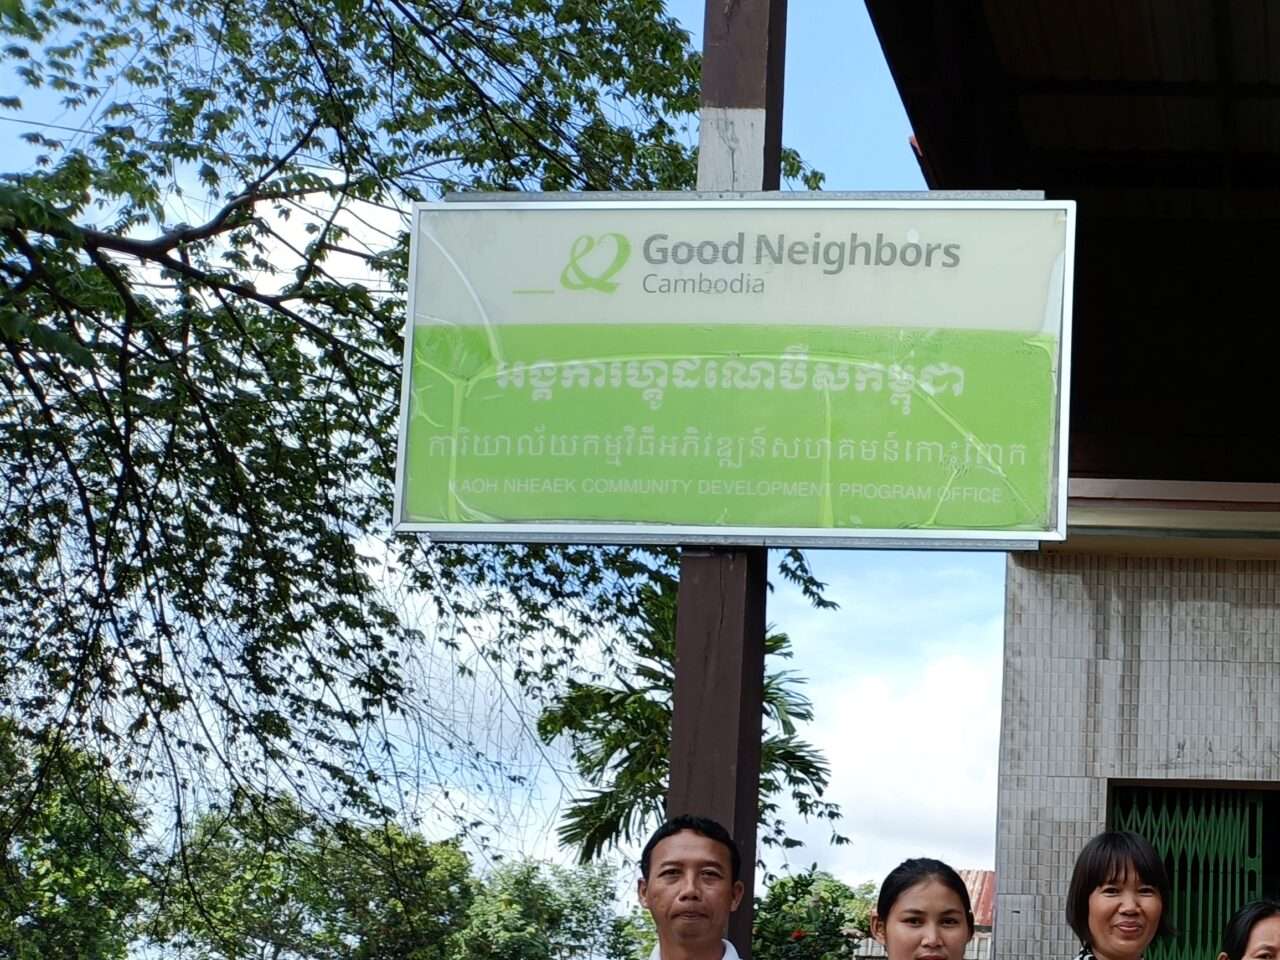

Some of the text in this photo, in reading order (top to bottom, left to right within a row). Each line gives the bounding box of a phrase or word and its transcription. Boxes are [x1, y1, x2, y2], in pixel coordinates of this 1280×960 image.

[643, 233, 960, 275] Good Neighbors
[642, 272, 765, 294] Cambodia
[503, 479, 577, 494] NHEAEK
[581, 479, 693, 495] COMMUNITY
[698, 480, 831, 498] DEVELOPMENT
[839, 481, 932, 500] PROGRAM
[937, 486, 1002, 504] OFFICE
